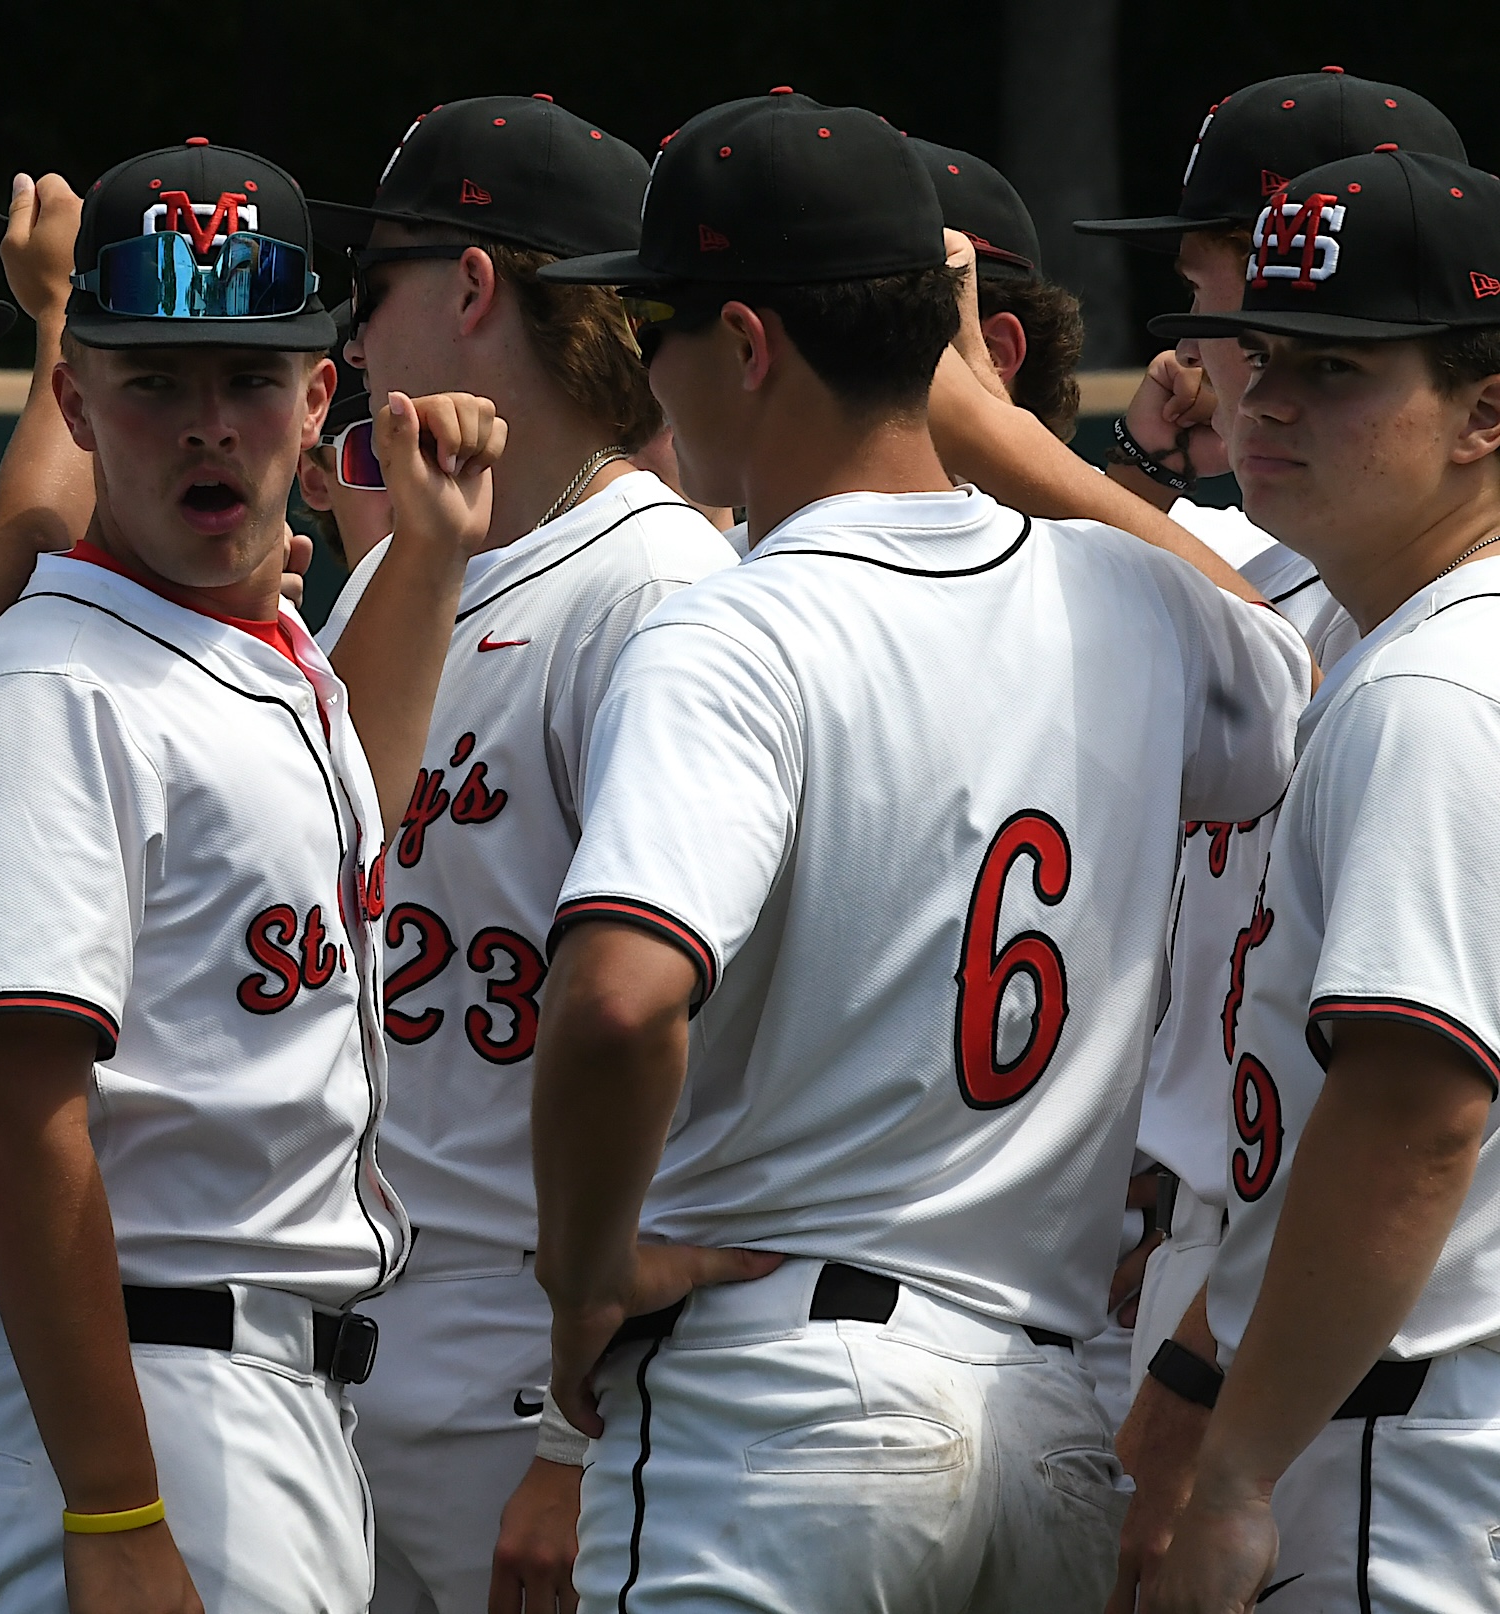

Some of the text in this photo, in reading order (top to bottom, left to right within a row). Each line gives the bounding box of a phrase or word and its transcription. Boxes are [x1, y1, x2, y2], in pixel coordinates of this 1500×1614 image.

[383, 902, 549, 1066] 23
[953, 807, 1073, 1111] 6
[1232, 1051, 1285, 1203] 9
